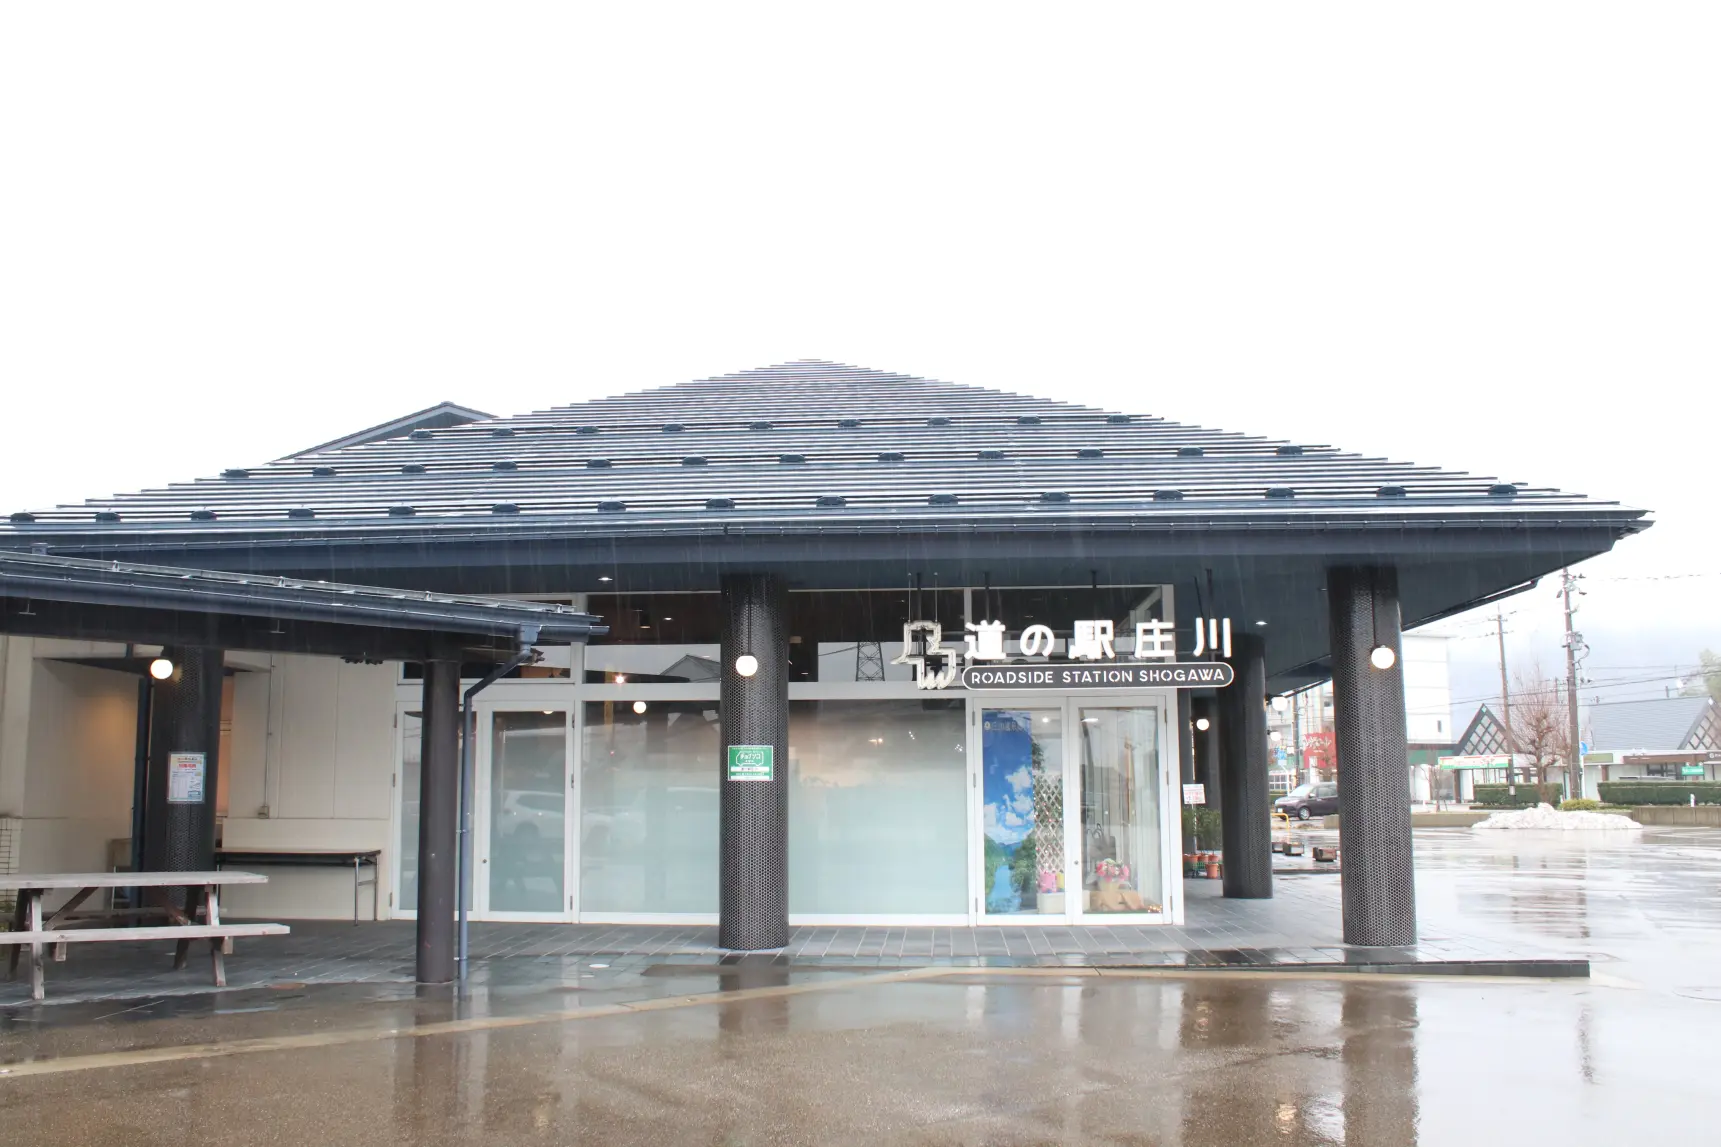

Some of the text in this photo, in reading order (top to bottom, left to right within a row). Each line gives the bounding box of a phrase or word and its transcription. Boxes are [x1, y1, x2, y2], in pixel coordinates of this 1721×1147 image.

[963, 617, 1233, 660] 道の駅庄川
[970, 668, 1226, 685] ROADSIDE STATION SHOGAWA
